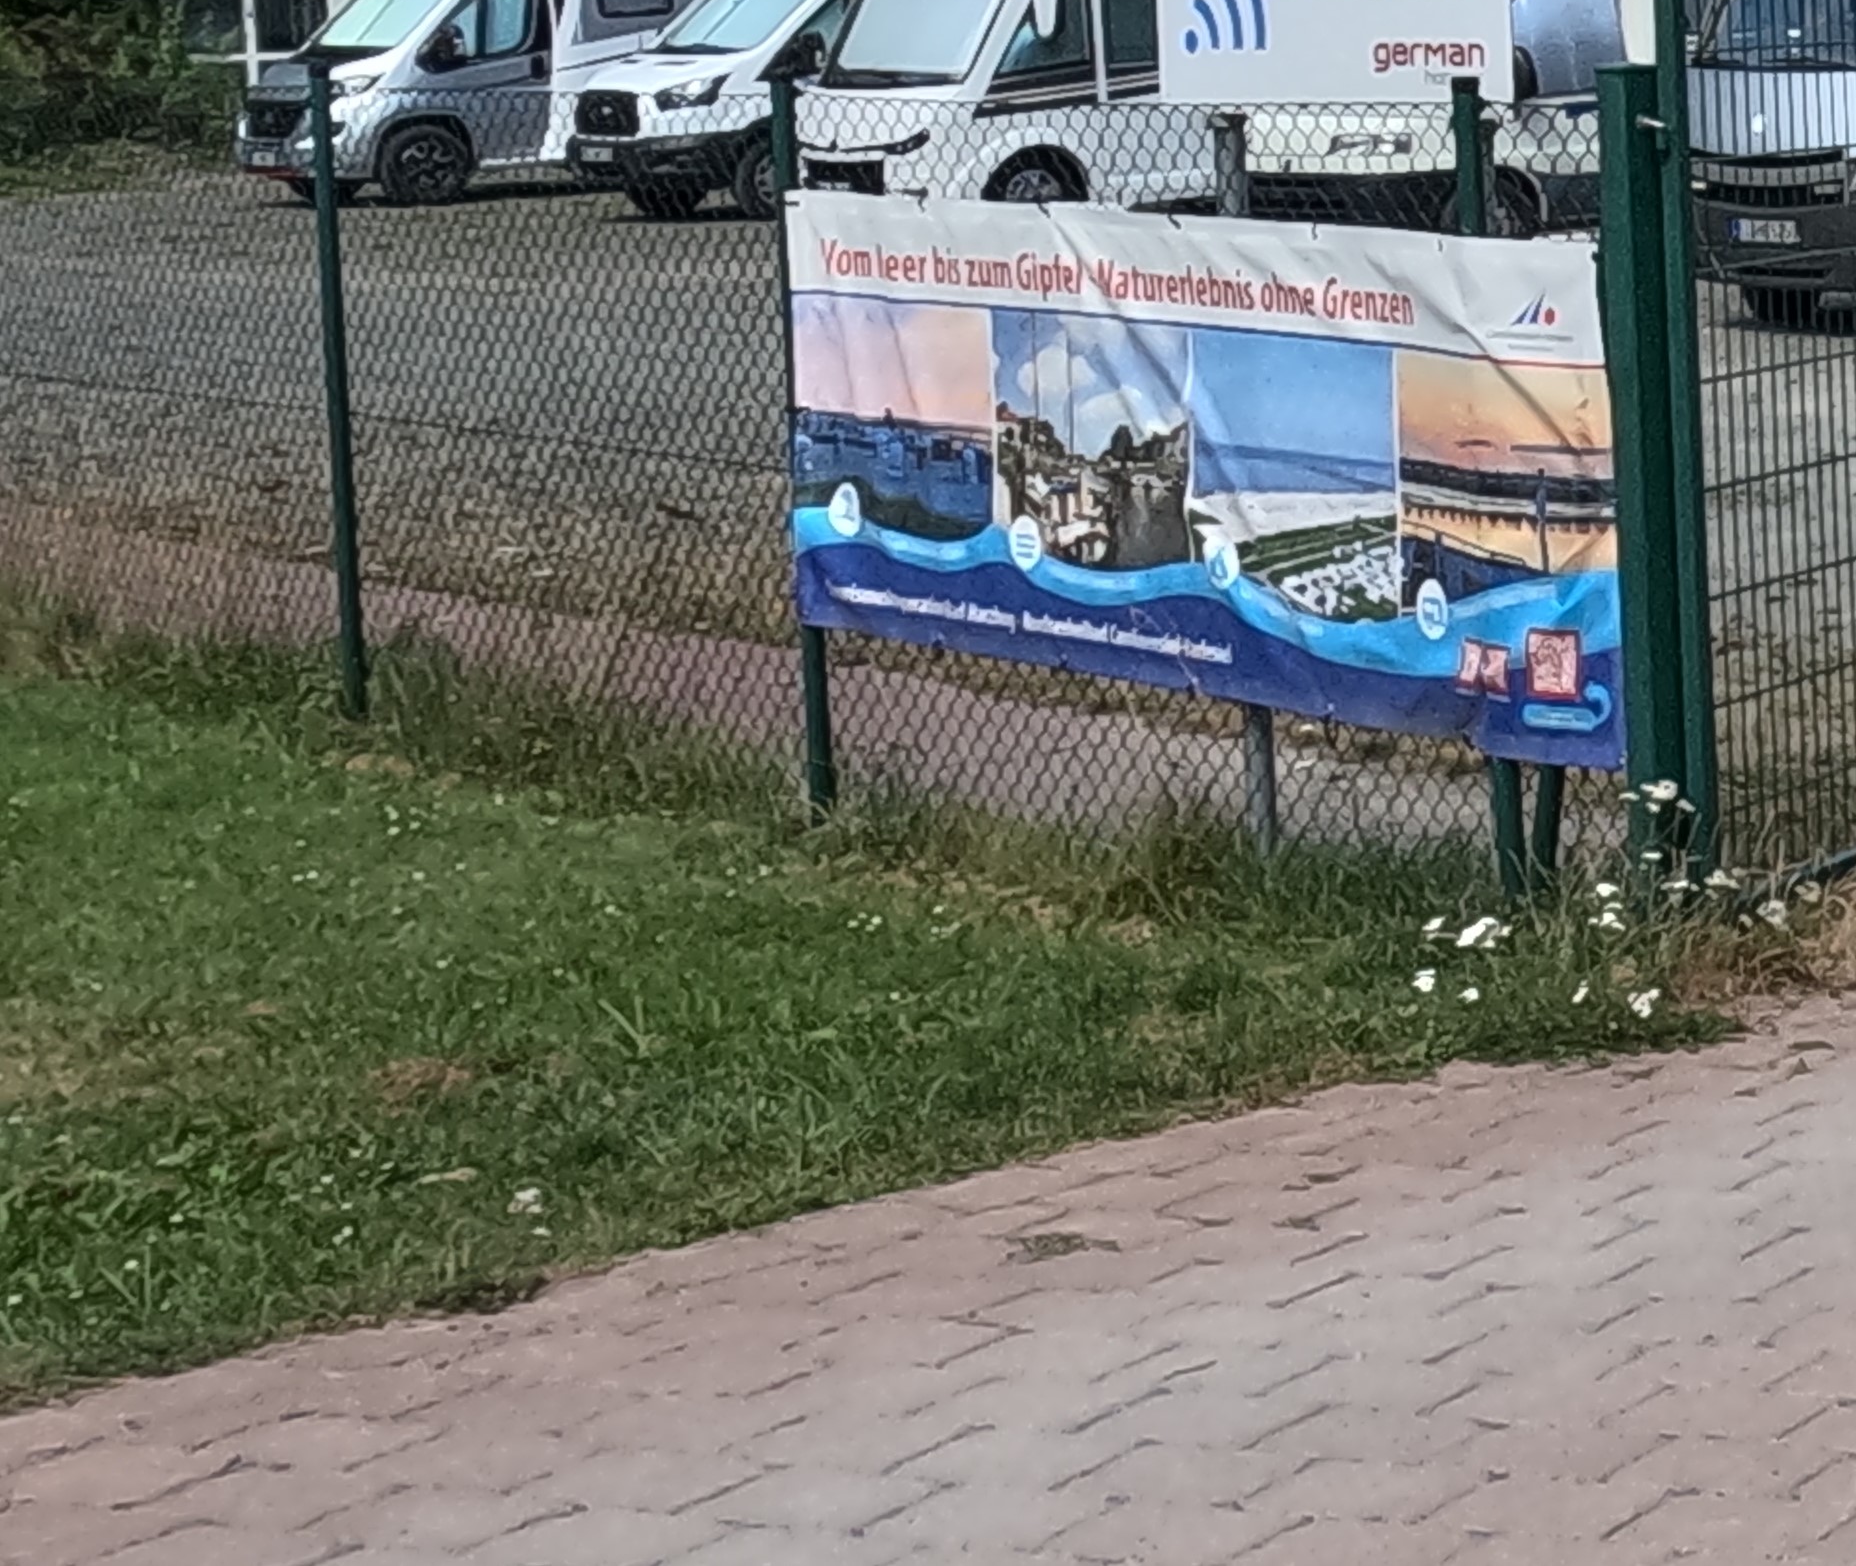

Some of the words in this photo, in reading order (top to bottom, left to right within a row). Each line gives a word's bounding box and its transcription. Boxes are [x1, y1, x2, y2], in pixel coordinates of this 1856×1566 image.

[1373, 41, 1486, 73] german
[819, 237, 872, 278] Vom
[931, 244, 961, 286] bis
[964, 258, 1013, 289] zum
[1015, 251, 1083, 301] Gipfel
[1097, 258, 1256, 311] Naturerlebnis
[1260, 270, 1316, 317] ohne
[1322, 276, 1415, 326] Grenzen
